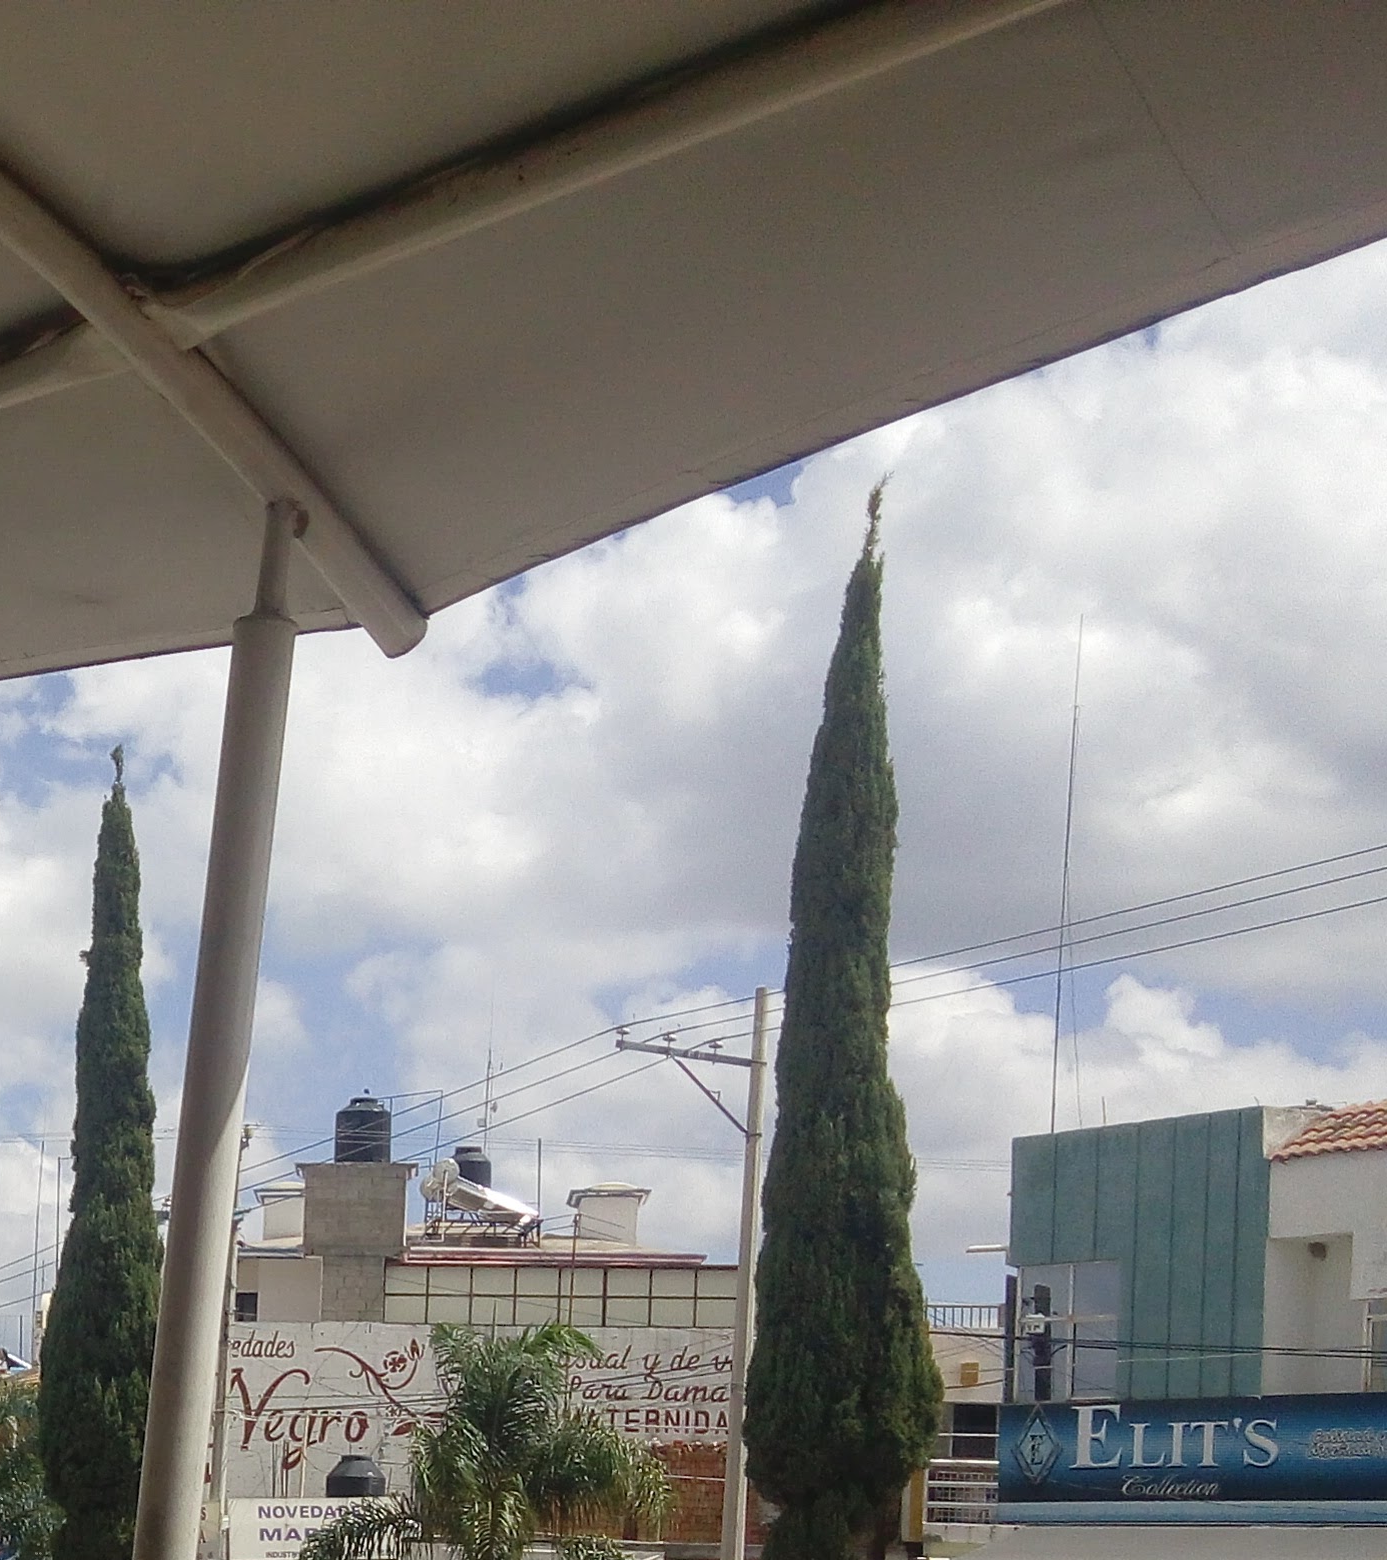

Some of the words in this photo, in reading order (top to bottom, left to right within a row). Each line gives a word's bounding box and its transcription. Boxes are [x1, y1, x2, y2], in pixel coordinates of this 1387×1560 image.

[670, 1346, 700, 1372] de
[576, 1408, 730, 1435] TERNIDA
[1121, 1473, 1220, 1498] Collection
[258, 1504, 372, 1520] NOVEDADE
